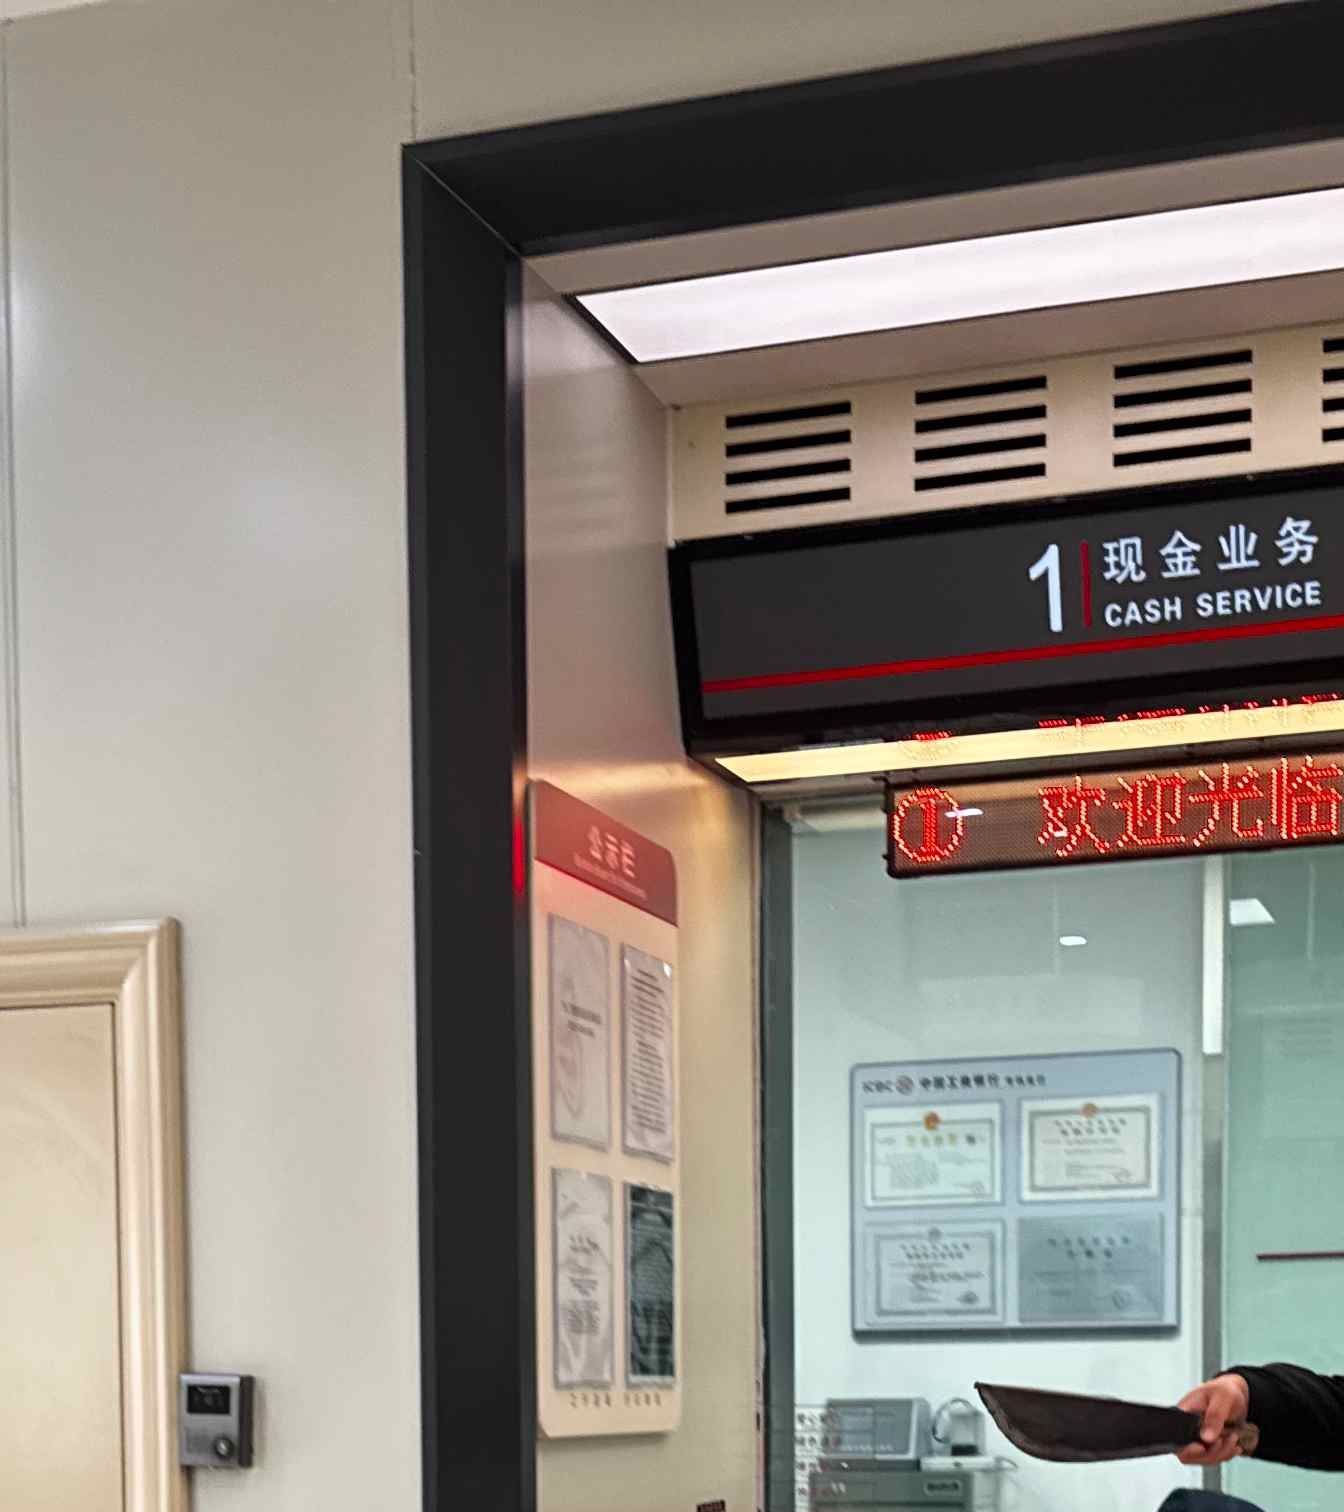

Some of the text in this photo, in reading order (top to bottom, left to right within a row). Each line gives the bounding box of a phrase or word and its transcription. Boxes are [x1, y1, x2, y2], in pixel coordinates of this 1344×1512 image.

[1028, 543, 1064, 632] 1
[1103, 516, 1320, 584] 现金业务
[1104, 579, 1323, 628] CASH SERVICE
[1038, 755, 1344, 858] 欢迎光临
